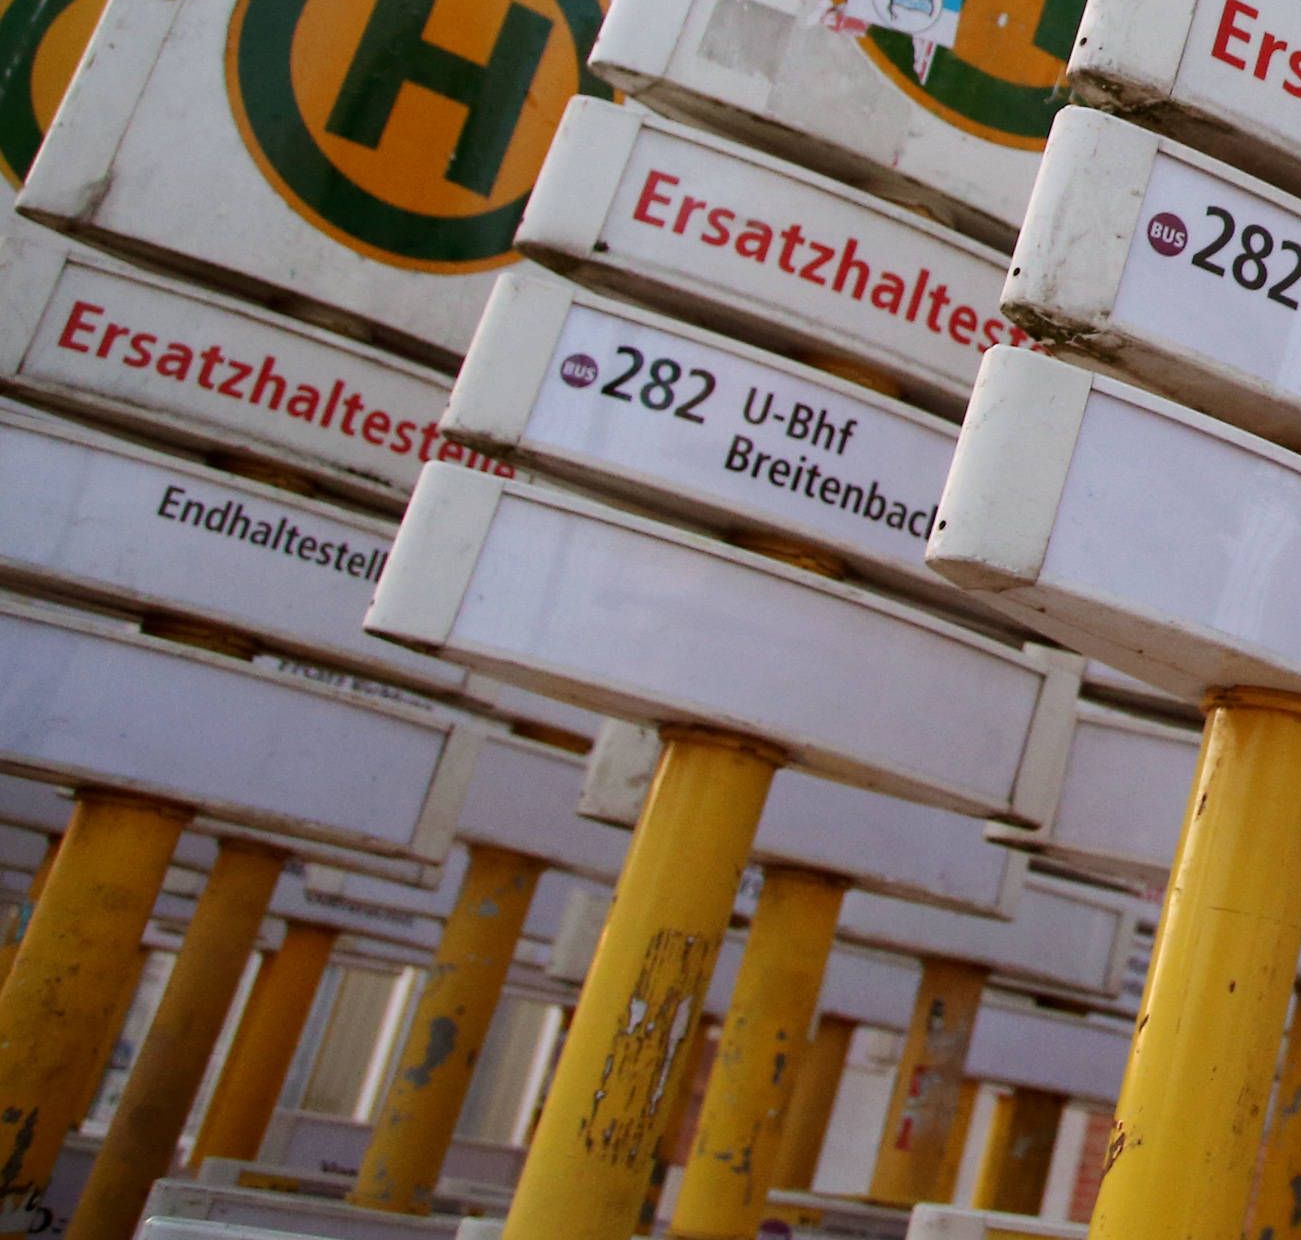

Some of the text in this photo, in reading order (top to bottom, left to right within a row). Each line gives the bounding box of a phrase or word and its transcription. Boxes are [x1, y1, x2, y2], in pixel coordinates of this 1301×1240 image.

[1149, 218, 1188, 250] BUS
[600, 345, 717, 425] 282
[742, 385, 858, 456] U-Bhf
